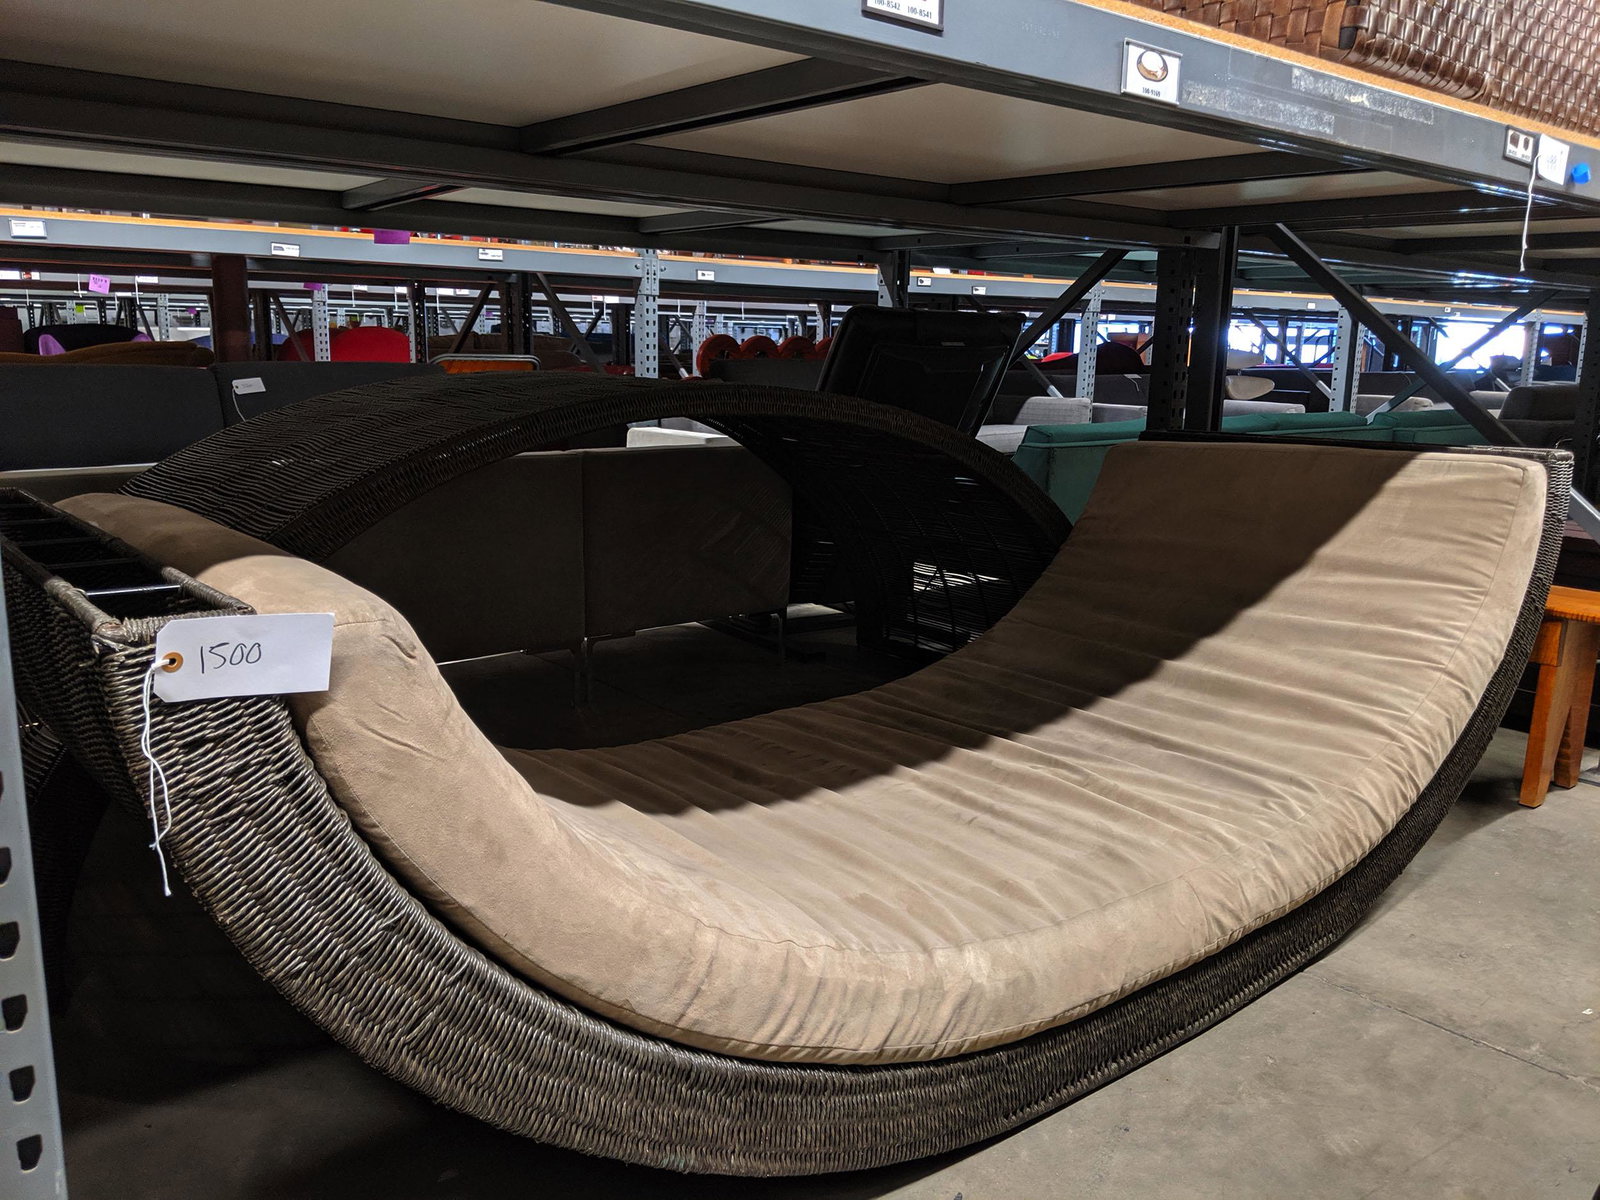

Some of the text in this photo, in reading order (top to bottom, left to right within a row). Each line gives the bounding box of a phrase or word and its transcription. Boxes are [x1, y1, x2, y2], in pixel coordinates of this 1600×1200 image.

[874, 0, 932, 19] 100-8542 100-8541
[200, 642, 262, 674] 1500
